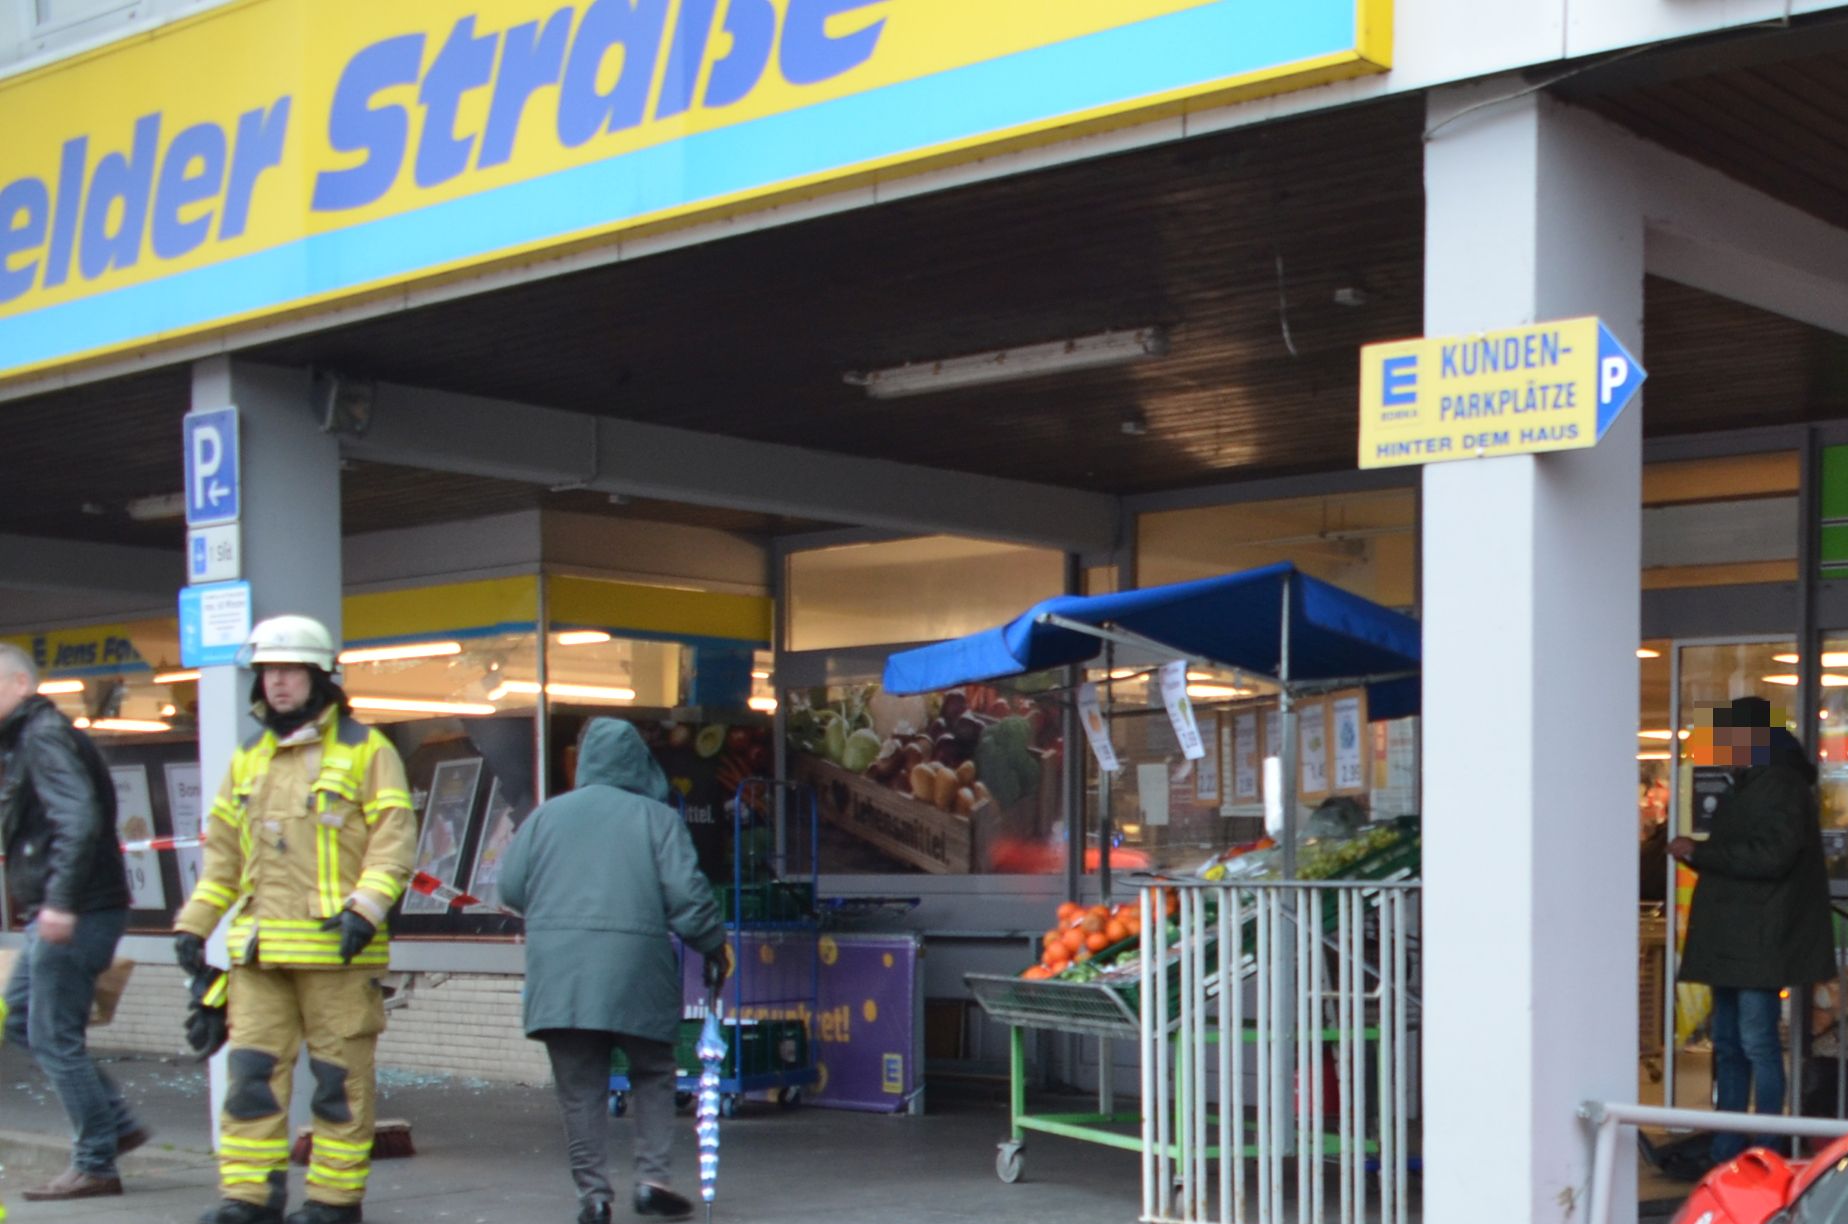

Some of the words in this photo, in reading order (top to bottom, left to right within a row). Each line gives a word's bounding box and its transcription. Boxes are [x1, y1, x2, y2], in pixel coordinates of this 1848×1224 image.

[1441, 331, 1573, 379] KUNDEN-
[1440, 380, 1577, 421] PARKPLÄTZE
[1376, 436, 1453, 458] HINTER
[1463, 430, 1510, 449] DEM
[1520, 423, 1579, 444] HAUS
[193, 426, 222, 510] P
